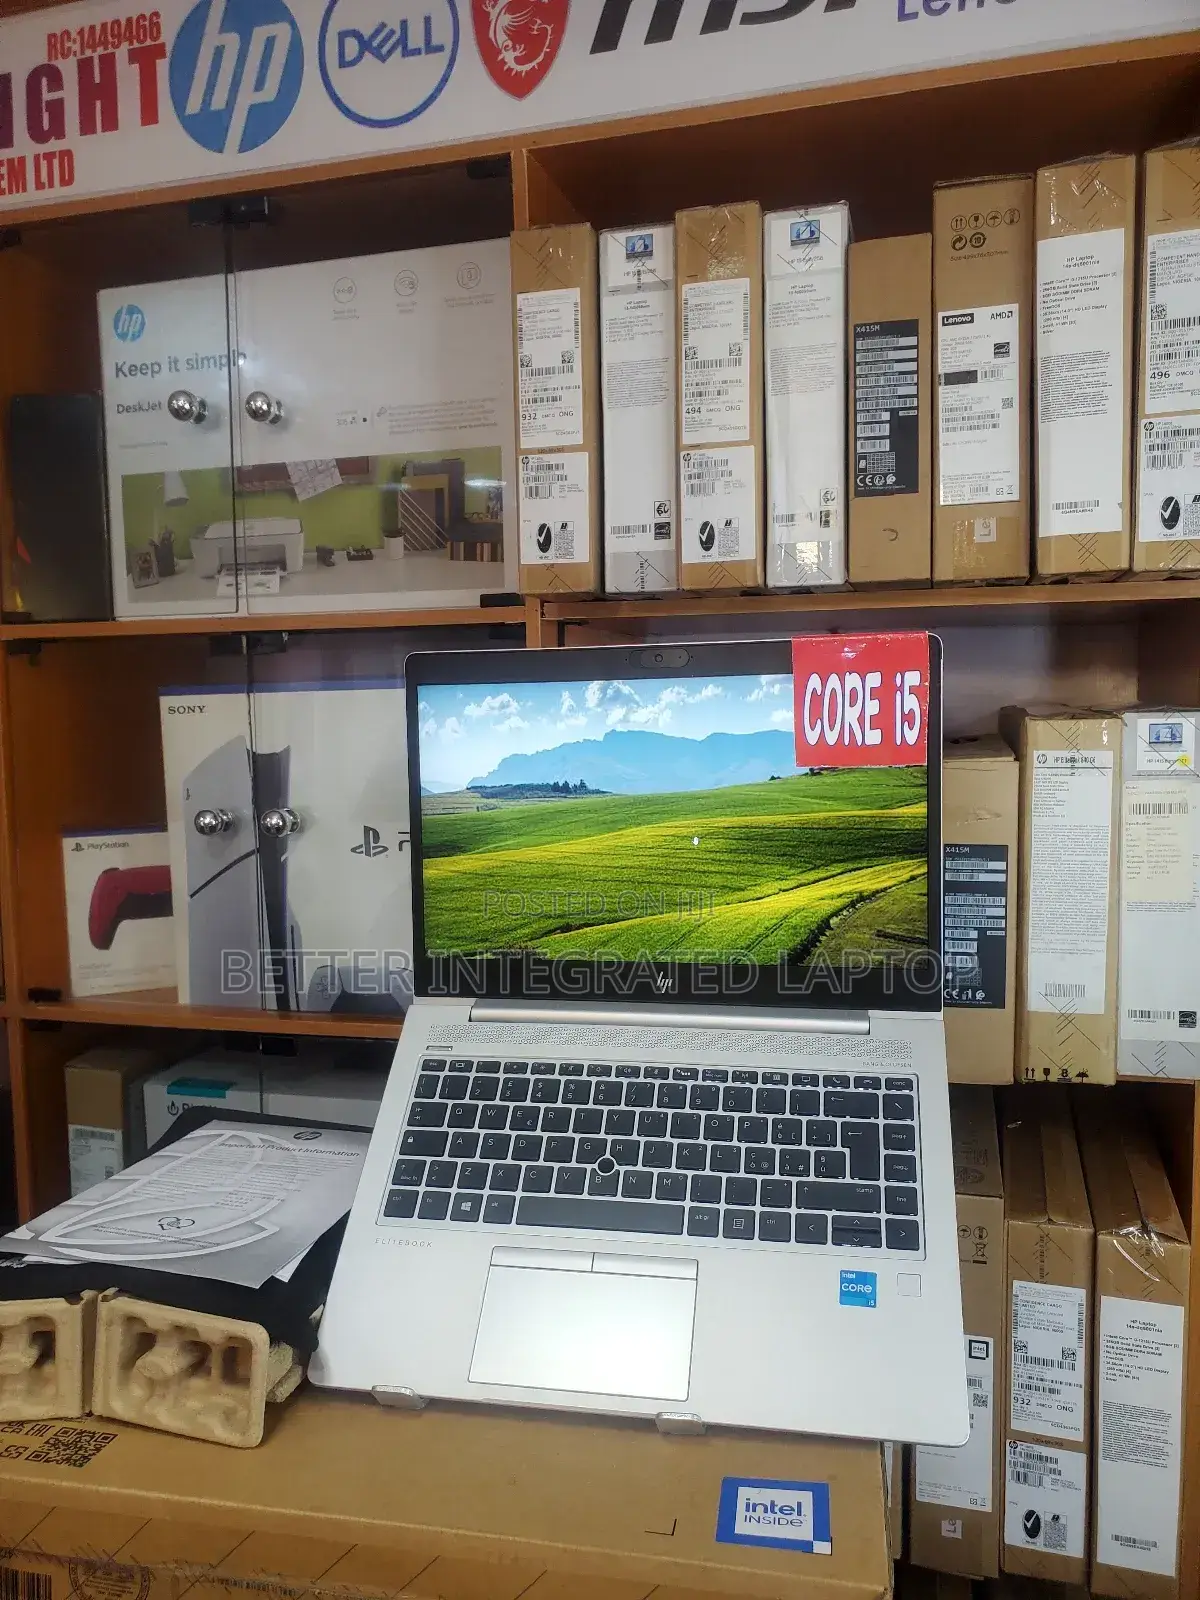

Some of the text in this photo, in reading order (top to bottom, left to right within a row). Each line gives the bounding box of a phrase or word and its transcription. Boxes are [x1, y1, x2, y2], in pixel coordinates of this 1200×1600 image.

[47, 12, 162, 61] RC:1449466
[337, 15, 445, 70] DELL
[180, 0, 295, 154] hp
[34, 149, 75, 191] LTD
[1075, 254, 1095, 262] Laptop
[115, 304, 144, 341] hp
[943, 311, 1008, 325] Lenovo AMD
[855, 324, 880, 333] X415M
[115, 361, 162, 379] Keep
[168, 356, 180, 373] it
[1149, 370, 1170, 380] 496
[116, 401, 162, 414] DeskJet
[521, 412, 537, 421] 932
[685, 404, 741, 415] 494 ONG
[167, 705, 206, 715] SONY
[802, 669, 923, 747] CORE i5
[87, 841, 130, 851] PlayStation
[455, 1107, 464, 1116] Q
[486, 1108, 496, 1116] W
[516, 1110, 523, 1118] E
[579, 1112, 586, 1120] T
[612, 1114, 619, 1122] Y
[644, 1115, 652, 1124] U
[743, 1121, 751, 1129] P
[218, 1142, 360, 1157] Important Product Information
[456, 1137, 464, 1145] A
[487, 1138, 494, 1146] S
[519, 1139, 527, 1147] D
[583, 1142, 591, 1150] G
[615, 1144, 623, 1152] H
[649, 1146, 655, 1154] J
[682, 1148, 690, 1156] K
[716, 1150, 723, 1158] L
[464, 1167, 471, 1175] Z
[497, 1169, 504, 1177] X
[529, 1170, 537, 1179] C
[562, 1172, 571, 1180] V
[595, 1175, 602, 1183] B
[628, 1176, 636, 1184] N
[663, 1178, 672, 1186] M
[1013, 1396, 1074, 1413] 932 ONG
[744, 1498, 804, 1518] intel
